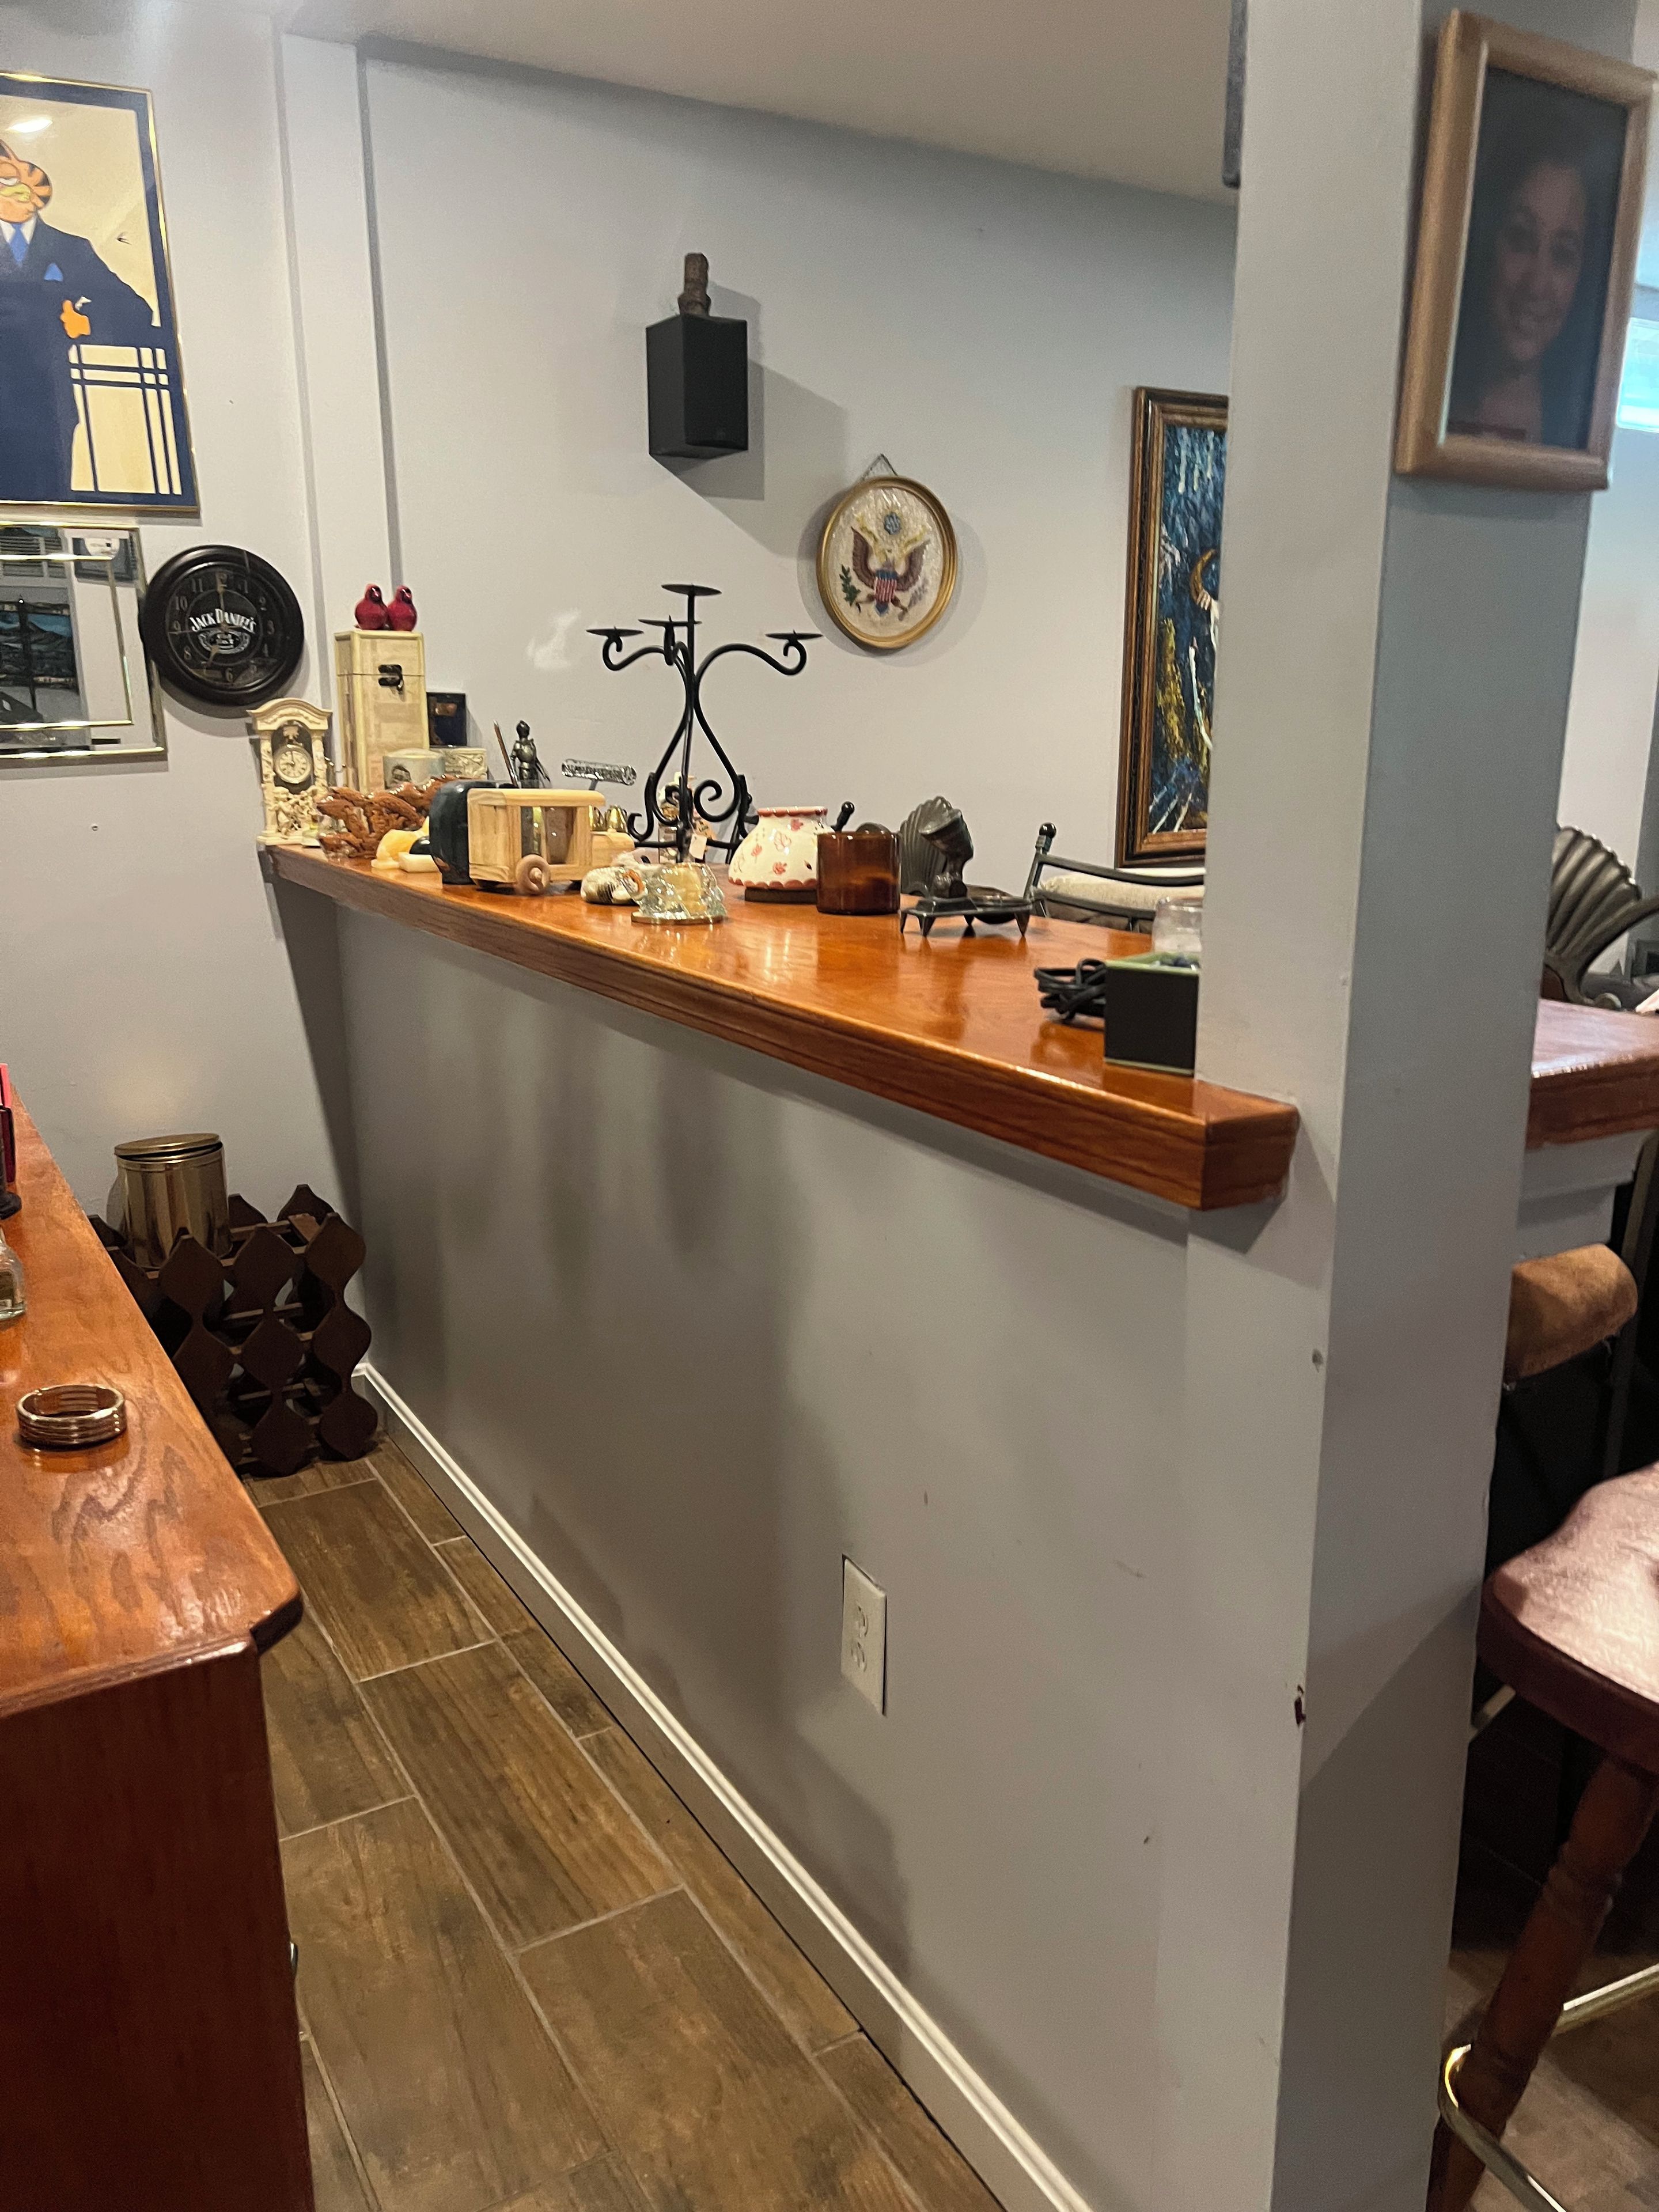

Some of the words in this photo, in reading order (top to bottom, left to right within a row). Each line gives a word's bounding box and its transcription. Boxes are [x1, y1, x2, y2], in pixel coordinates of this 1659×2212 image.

[175, 596, 188, 611] 10
[173, 620, 181, 635] 9
[225, 668, 233, 682] 6
